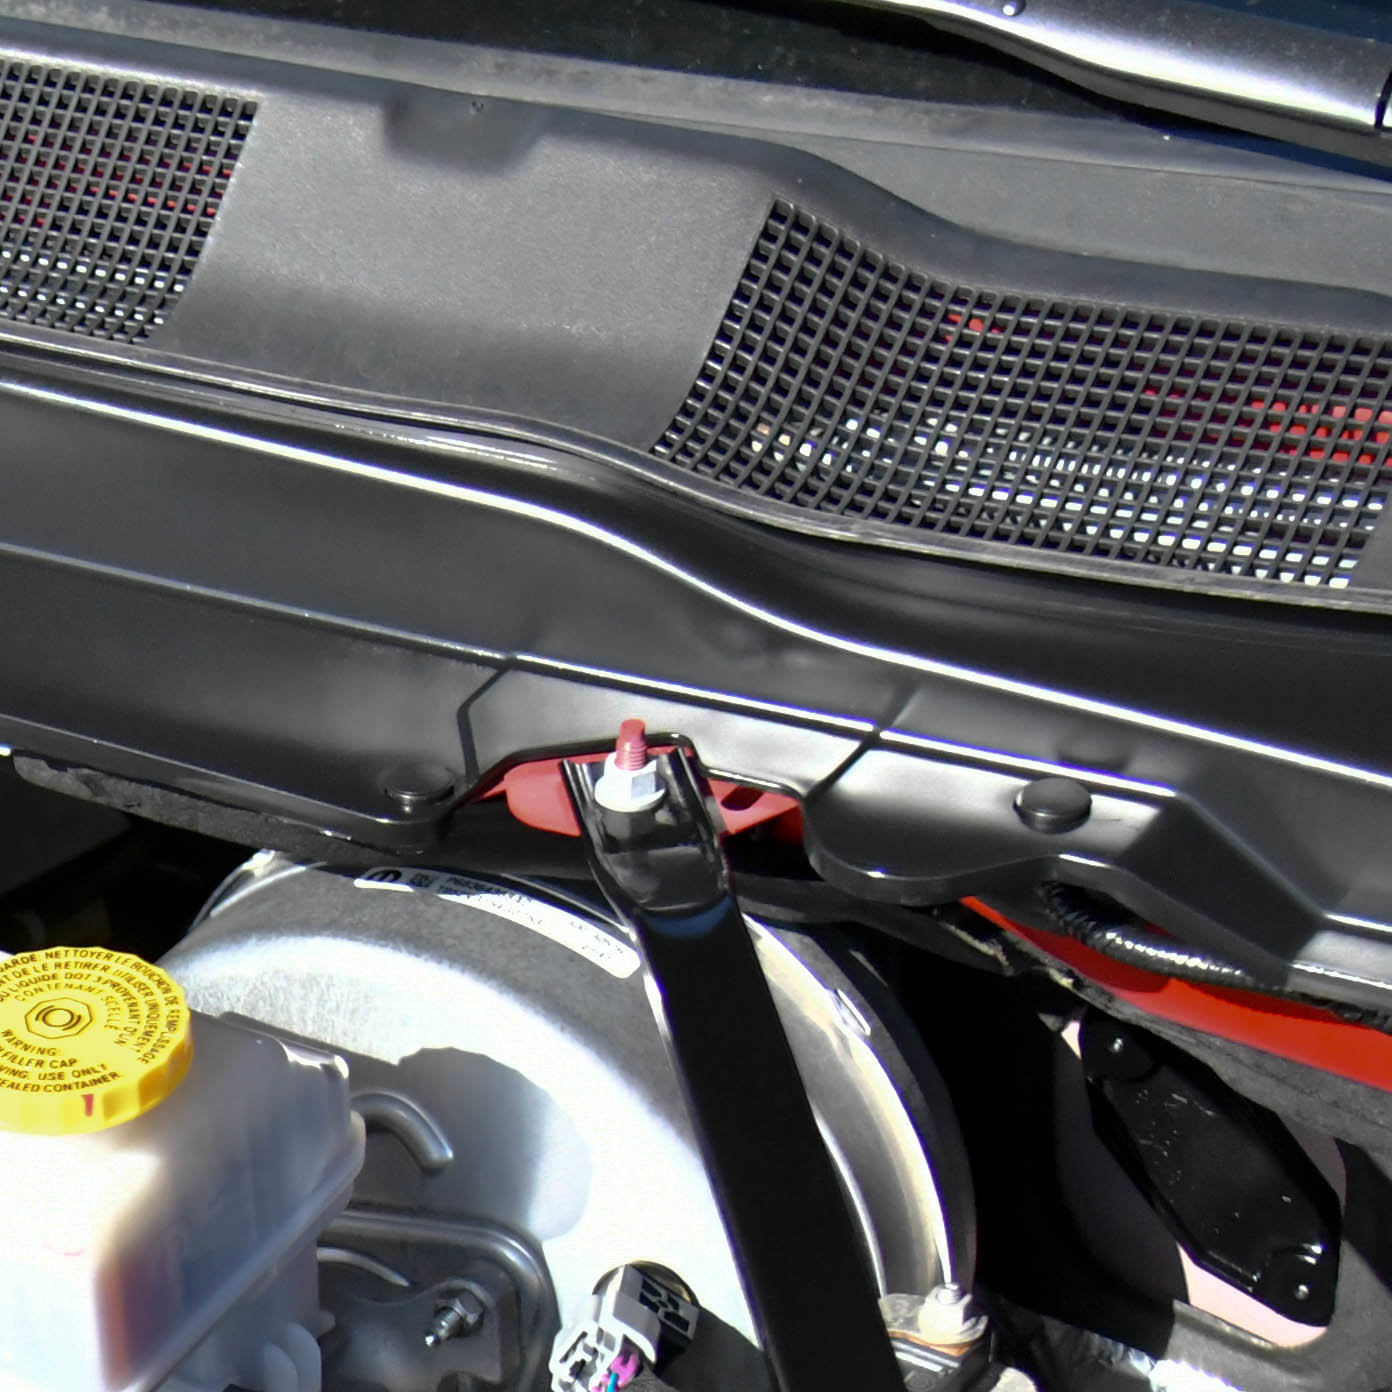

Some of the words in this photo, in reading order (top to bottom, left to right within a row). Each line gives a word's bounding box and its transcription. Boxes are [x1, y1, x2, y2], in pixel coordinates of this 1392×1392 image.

[45, 950, 114, 961] NETTOYER
[115, 956, 130, 965] LE
[12, 967, 30, 978] DE
[33, 963, 49, 973] LE
[8, 973, 57, 993] LIQUIDE
[14, 983, 104, 1001] CONTENANT
[2, 1051, 44, 1068] FILLER
[49, 1058, 77, 1069] CAP
[38, 1072, 65, 1080] USE
[72, 1064, 107, 1078] ONLY
